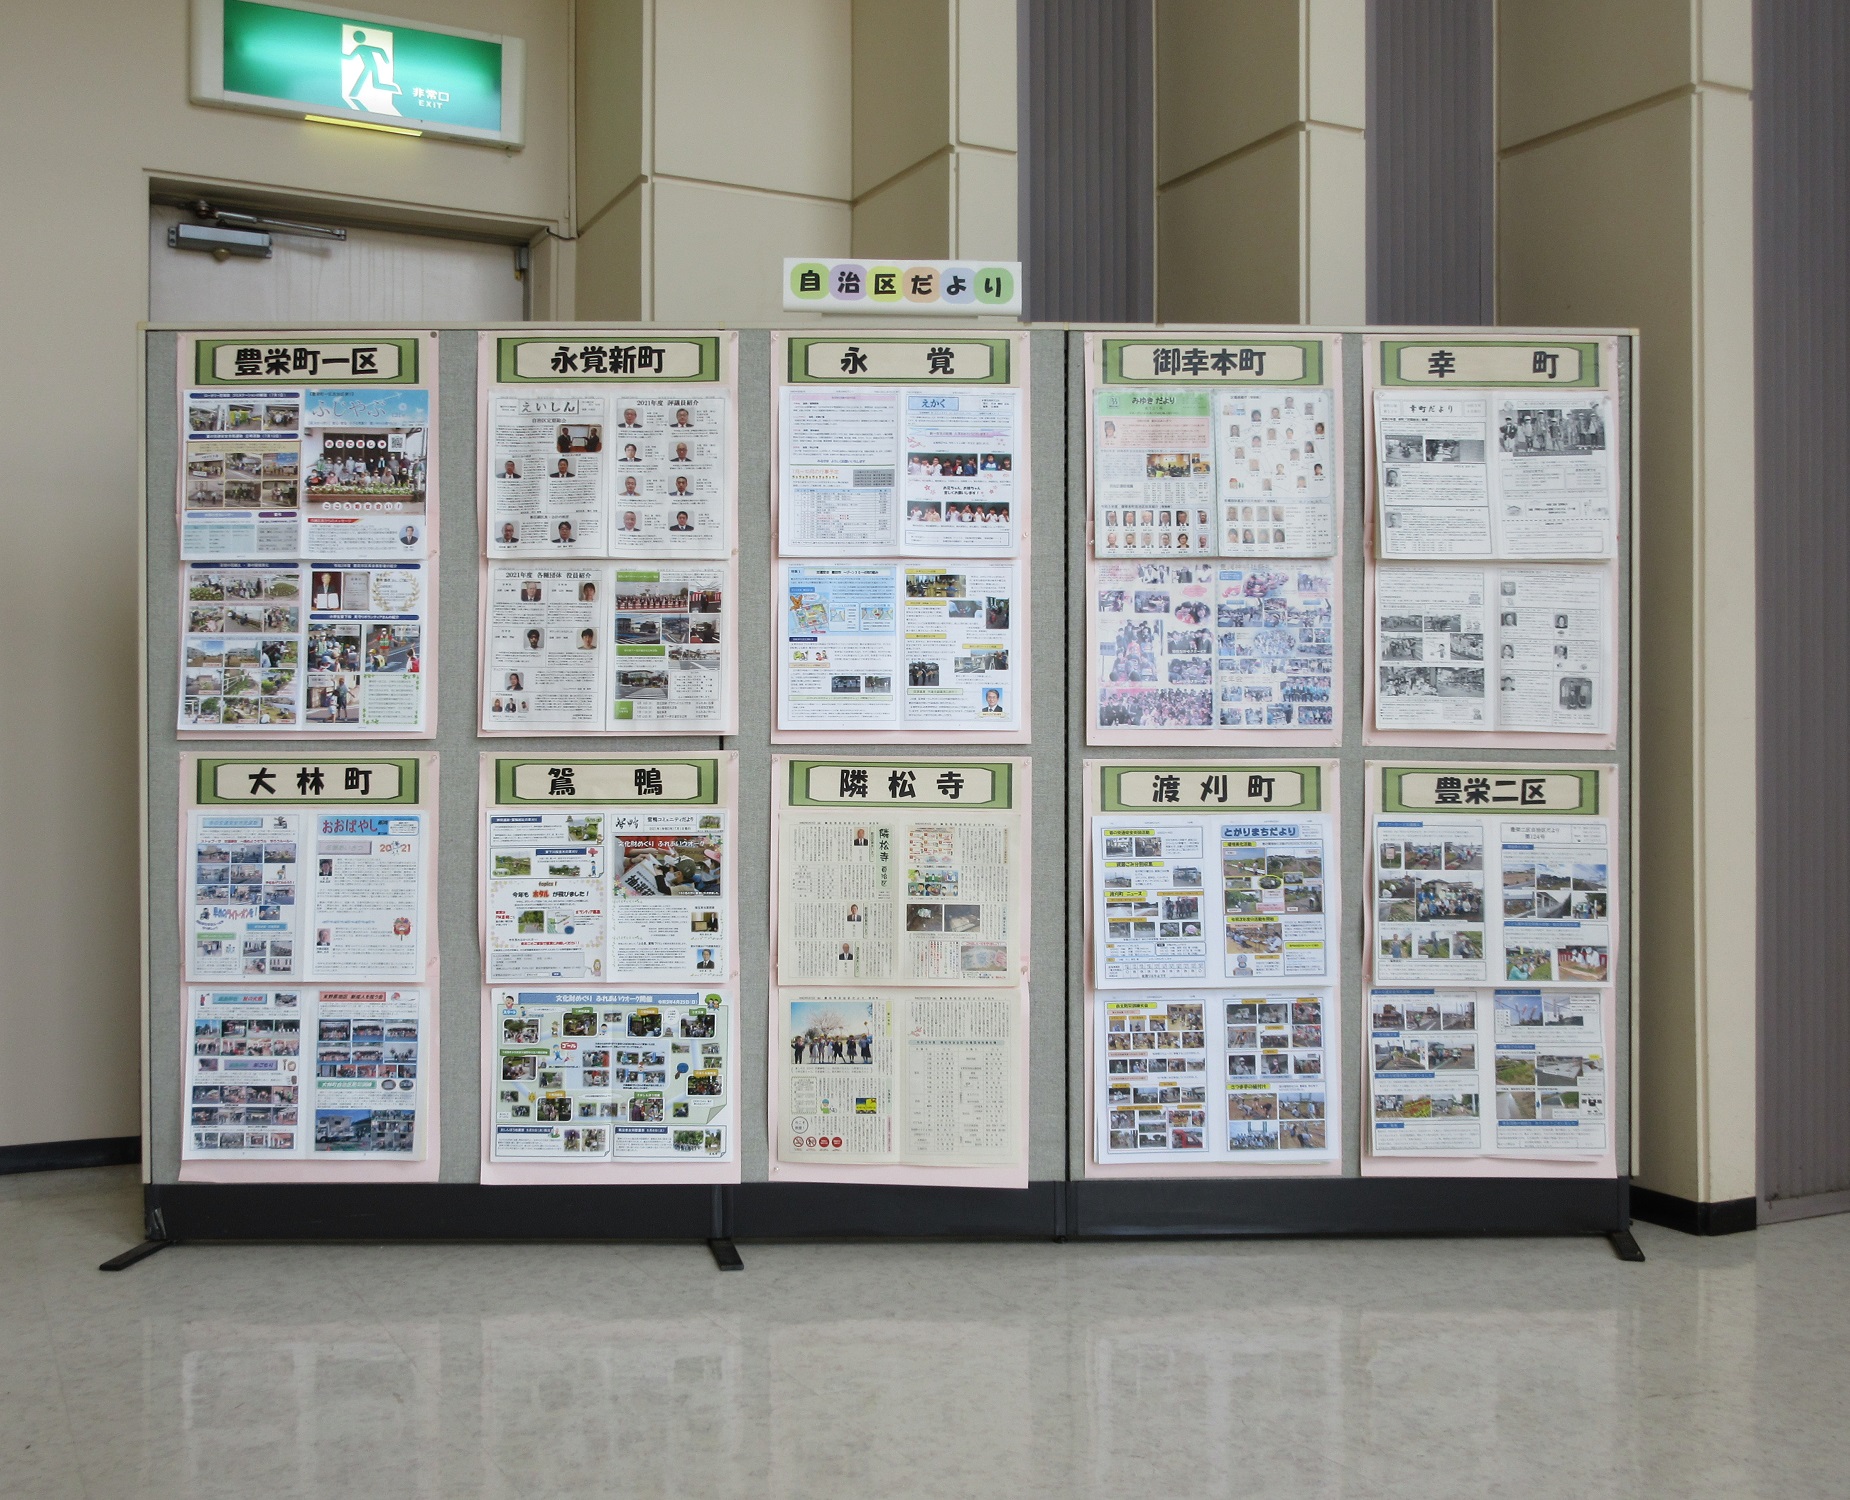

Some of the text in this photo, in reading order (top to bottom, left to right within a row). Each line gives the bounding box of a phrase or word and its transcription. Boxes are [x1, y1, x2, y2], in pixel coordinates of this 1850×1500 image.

[412, 87, 450, 102] 非常口
[418, 100, 443, 109] EXIT
[800, 269, 1002, 298] 自治区だより
[234, 347, 378, 376] 豊栄町一区
[551, 346, 666, 374] 永覚新町
[840, 346, 955, 375] 永覚
[1153, 347, 1267, 376] 御幸本町
[1428, 350, 1559, 379] 幸町
[312, 400, 386, 418] ふじやぶ
[521, 400, 576, 414] えいしん
[921, 398, 946, 409] えかく
[1131, 396, 1176, 405] みゆき だより
[248, 767, 372, 796] 大林町
[547, 767, 663, 796] 鴛鴨
[839, 769, 965, 799] 隣松寺
[1152, 774, 1275, 803] 渡刈町
[1434, 776, 1547, 805] 豊栄二区
[1224, 827, 1297, 837] とがりまちだより
